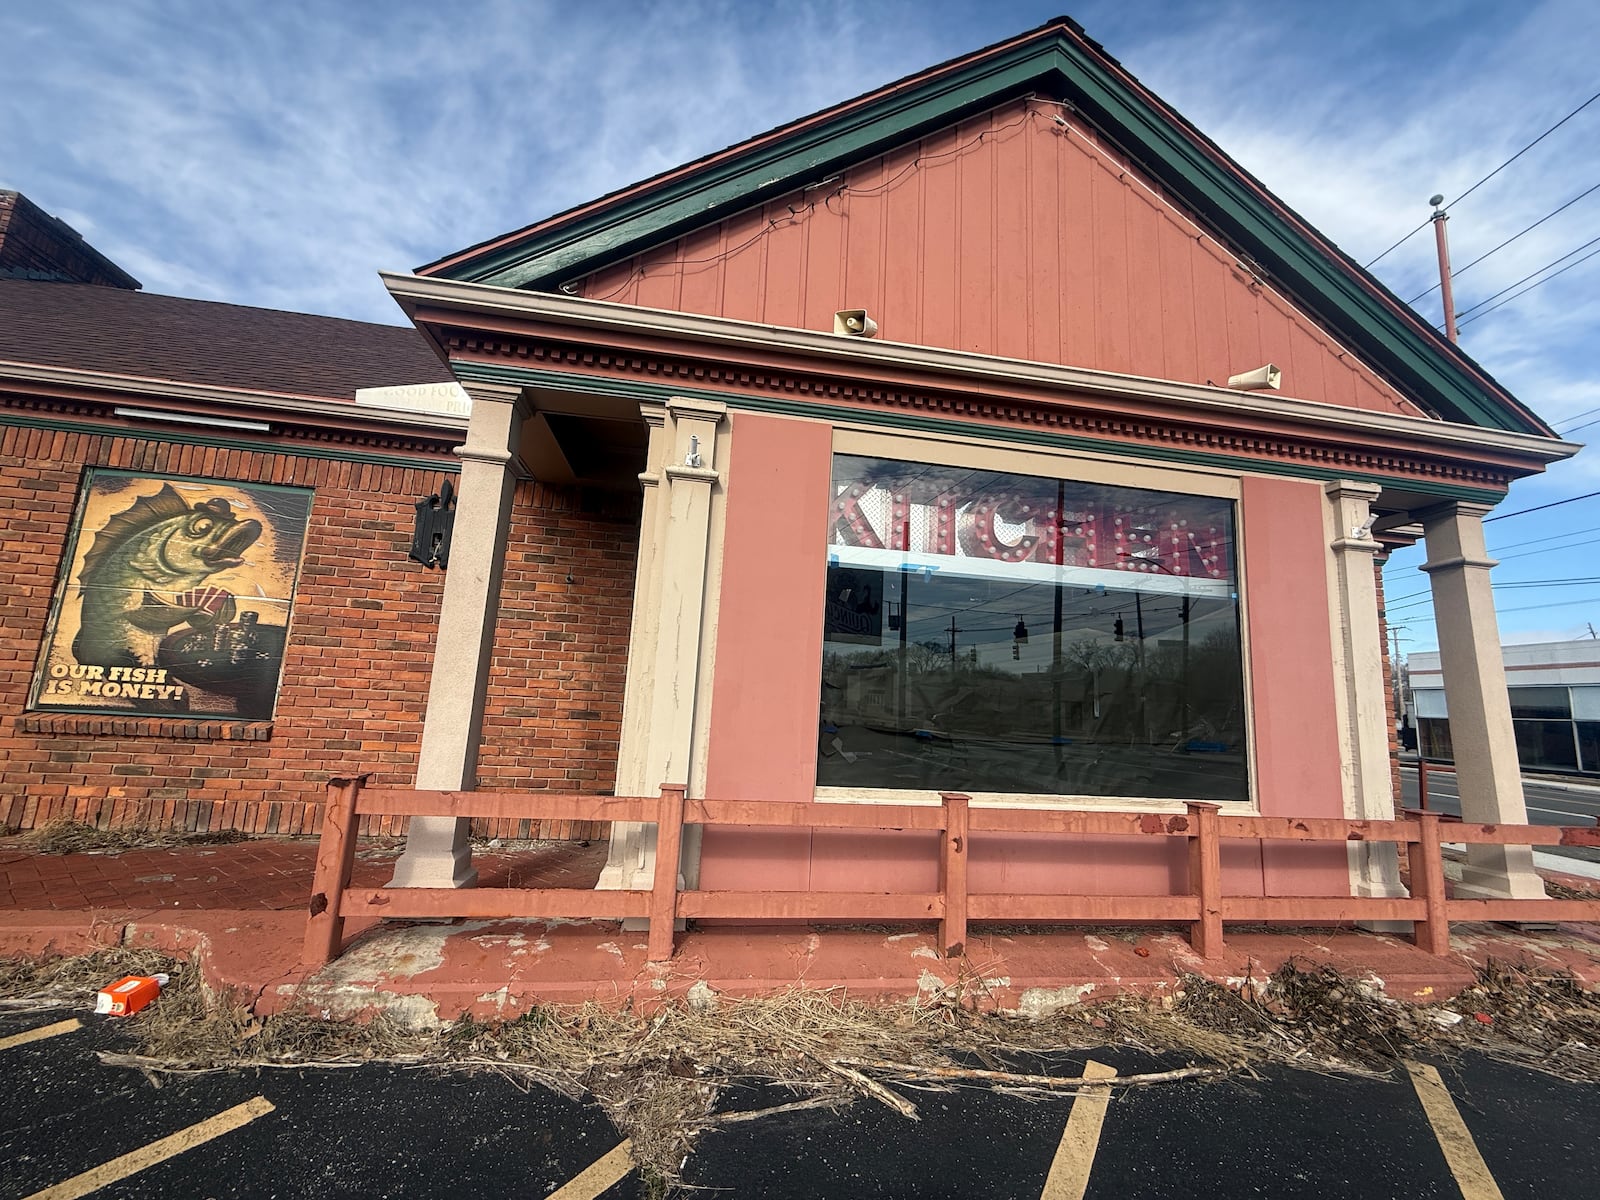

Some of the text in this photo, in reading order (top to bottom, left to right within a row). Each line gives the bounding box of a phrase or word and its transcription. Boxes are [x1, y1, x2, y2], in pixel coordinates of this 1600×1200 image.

[829, 477, 1227, 580] KITCHEN
[50, 664, 167, 683] OUR FISH
[46, 679, 183, 700] IS MONEY!
